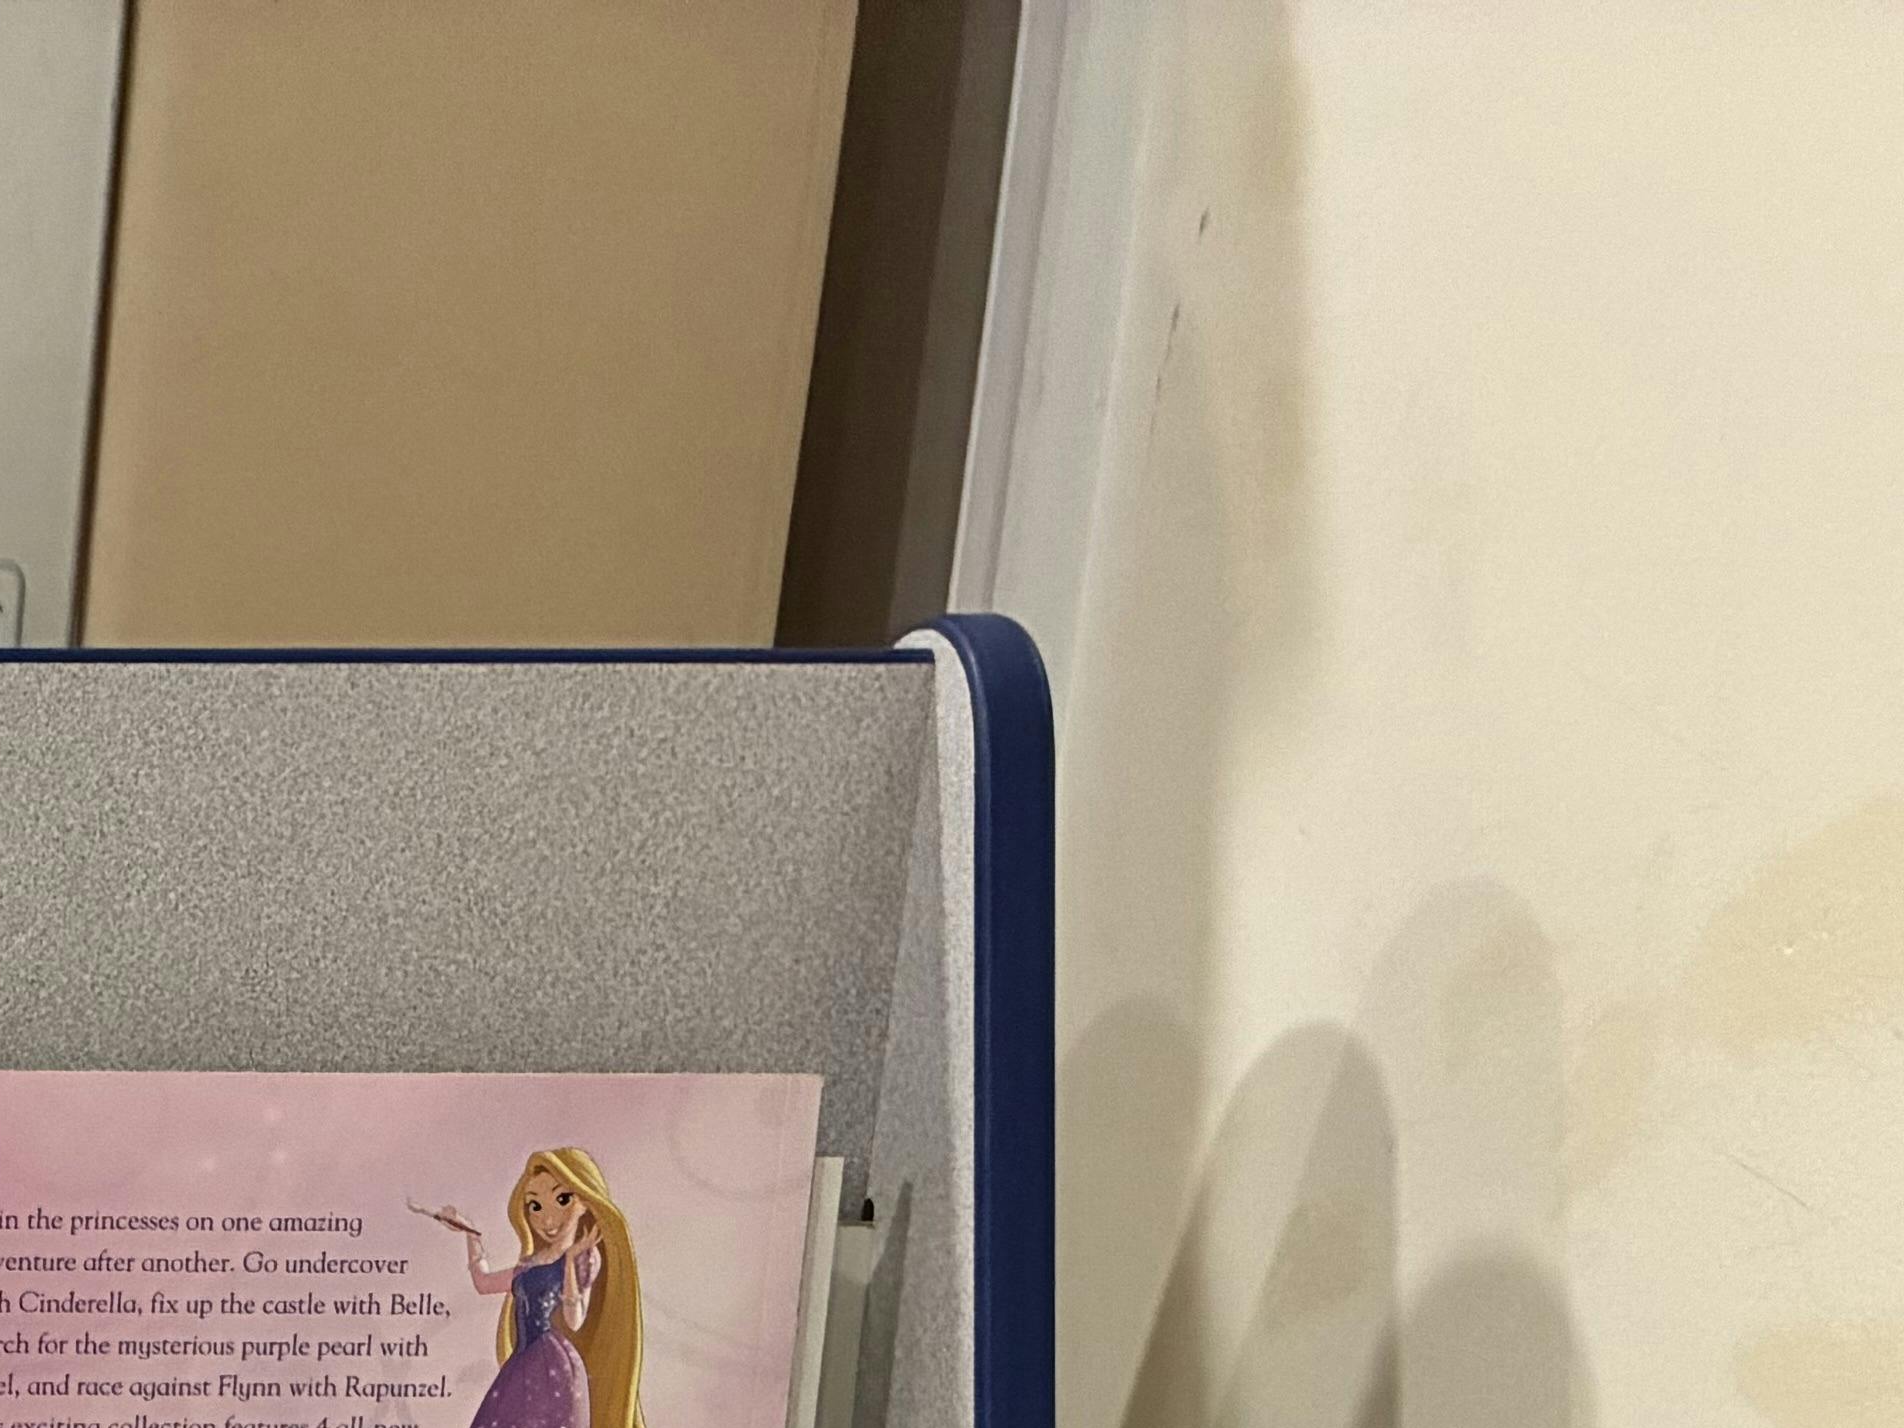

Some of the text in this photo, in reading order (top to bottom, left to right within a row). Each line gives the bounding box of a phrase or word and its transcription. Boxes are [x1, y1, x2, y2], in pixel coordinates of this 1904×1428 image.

[27, 1209, 63, 1233] the
[70, 1209, 180, 1237] princesses
[186, 1214, 214, 1233] on
[221, 1214, 263, 1234] one
[268, 1213, 363, 1238] amazing
[83, 1251, 135, 1274] after
[141, 1251, 236, 1275] another.
[243, 1252, 278, 1275] Go
[285, 1254, 409, 1276] undercover
